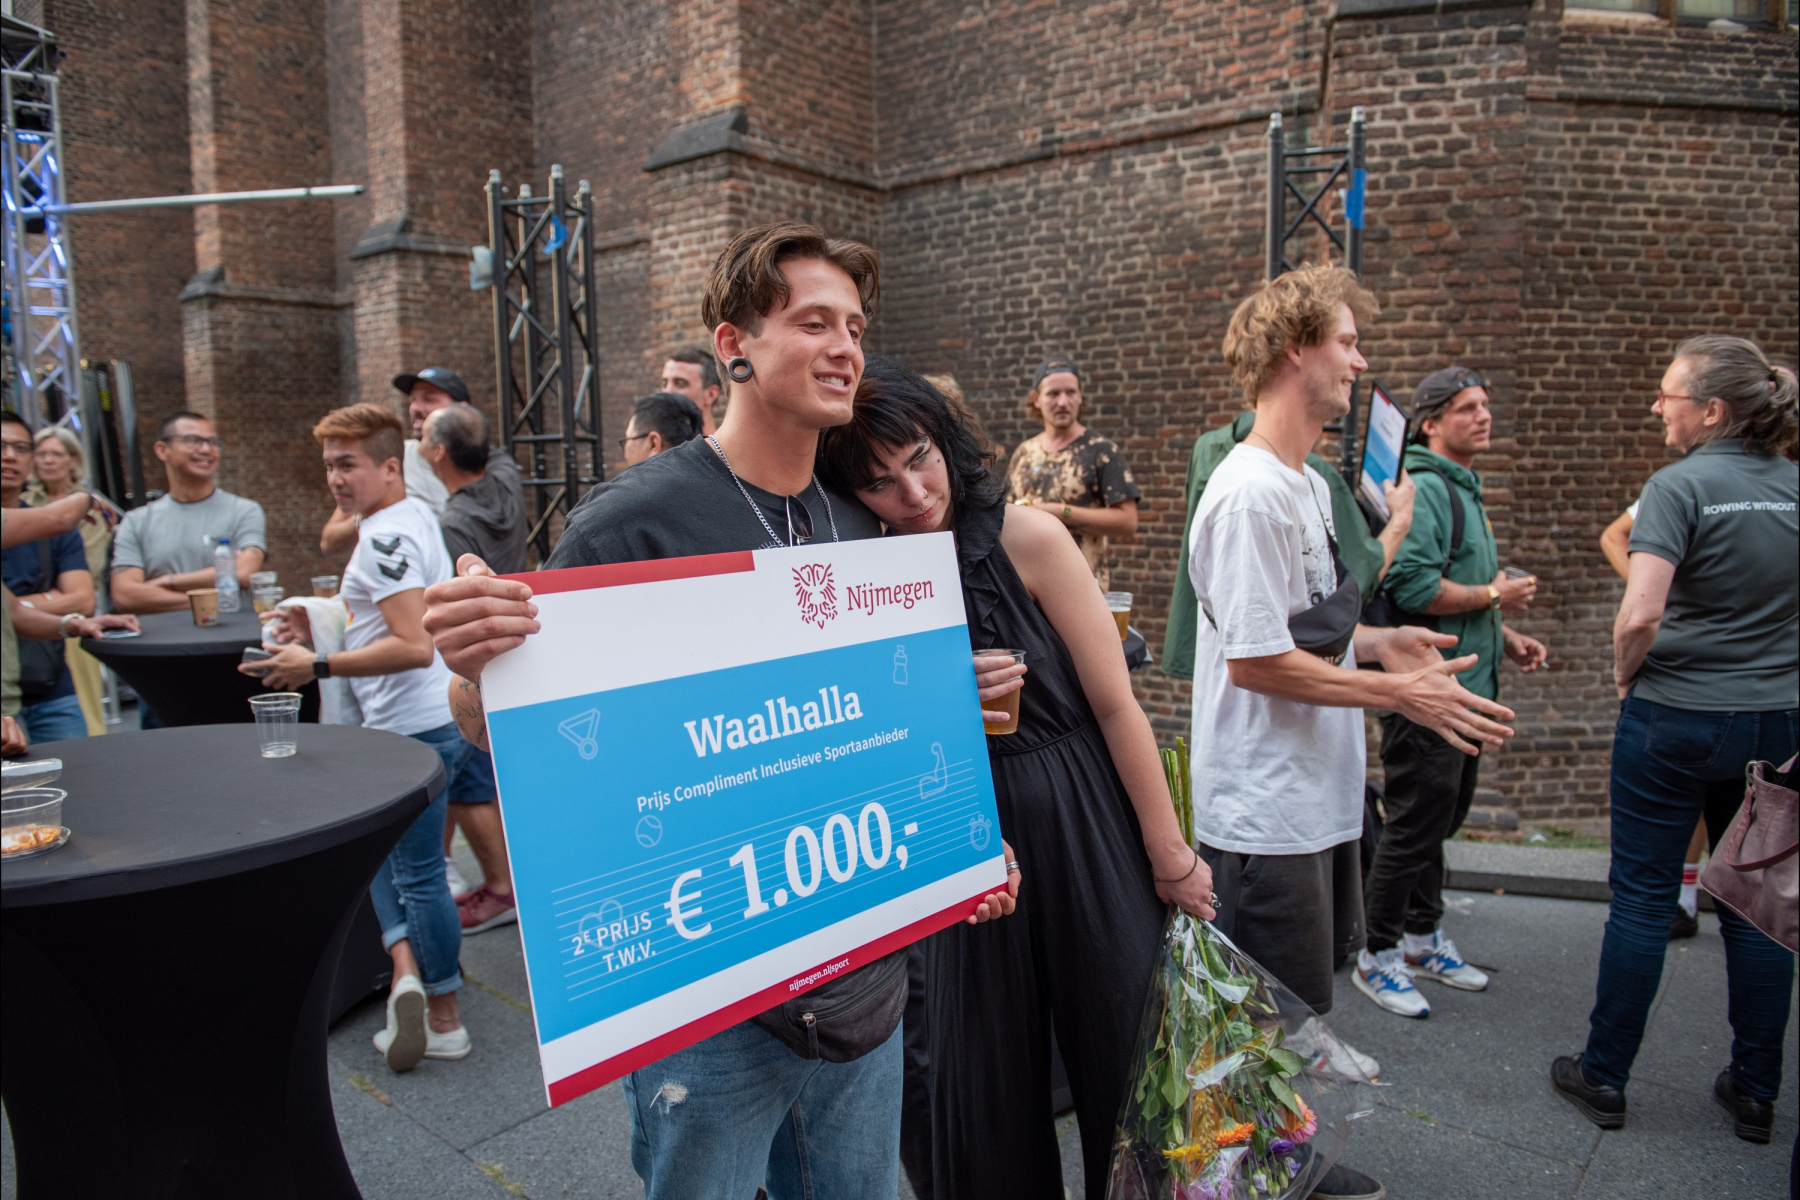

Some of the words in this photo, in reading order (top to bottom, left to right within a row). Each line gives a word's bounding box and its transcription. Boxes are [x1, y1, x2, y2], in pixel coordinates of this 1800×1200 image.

[1702, 501, 1752, 516] ROWING
[1752, 501, 1797, 512] WITHOUT
[846, 580, 935, 616] Nijmegen
[684, 685, 864, 758] Waalhalla
[637, 788, 671, 812] Prijs
[674, 766, 759, 802] Compliment
[760, 751, 822, 779] Inclusieve
[824, 726, 910, 762] Sportaanbieder
[596, 912, 652, 947] PRIJS
[663, 868, 713, 940] €
[729, 802, 919, 919] 1.000,-
[602, 939, 656, 973] T.W.V.
[788, 957, 850, 992] nijmegen.nl/sport
